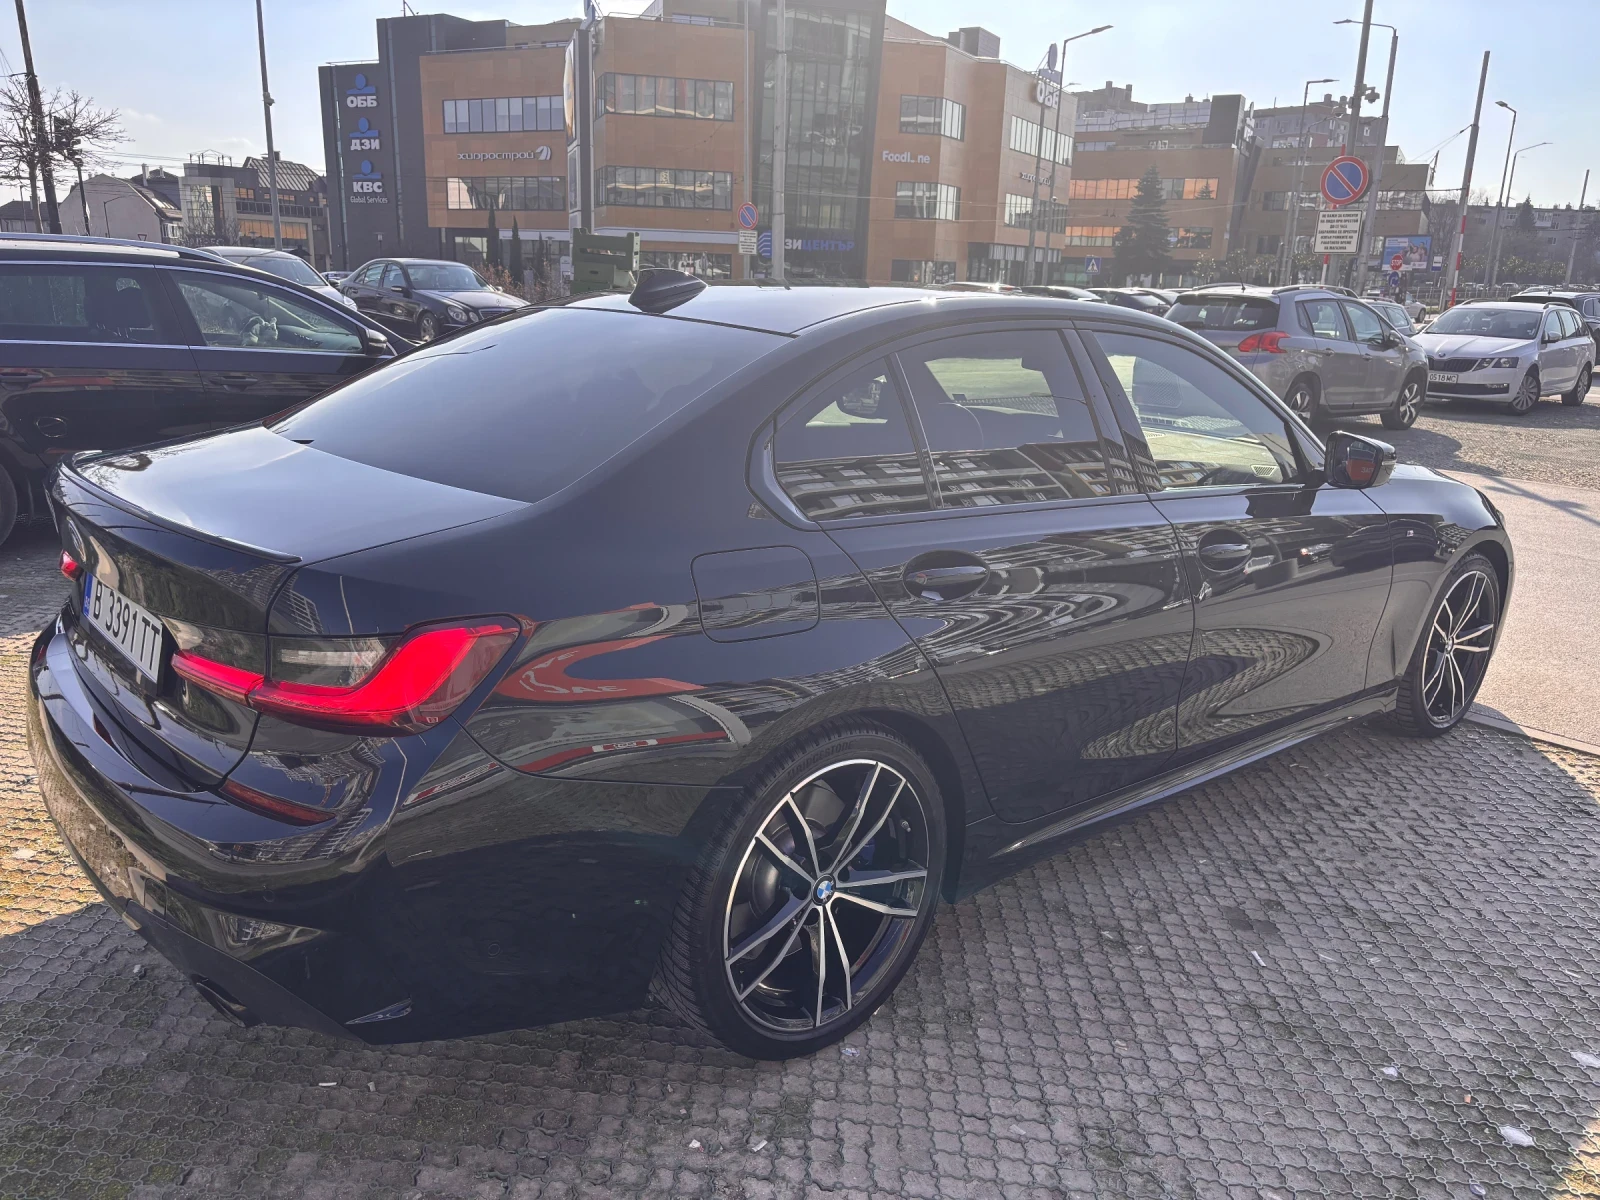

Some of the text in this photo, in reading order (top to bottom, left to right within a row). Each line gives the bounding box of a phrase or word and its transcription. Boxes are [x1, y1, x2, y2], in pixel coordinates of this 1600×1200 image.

[346, 96, 377, 108] ОББ
[350, 139, 380, 151] ДЗИ
[353, 181, 383, 193] KBC
[350, 195, 388, 204] Global Services
[105, 590, 138, 653] 3391
[141, 615, 161, 671] TT
